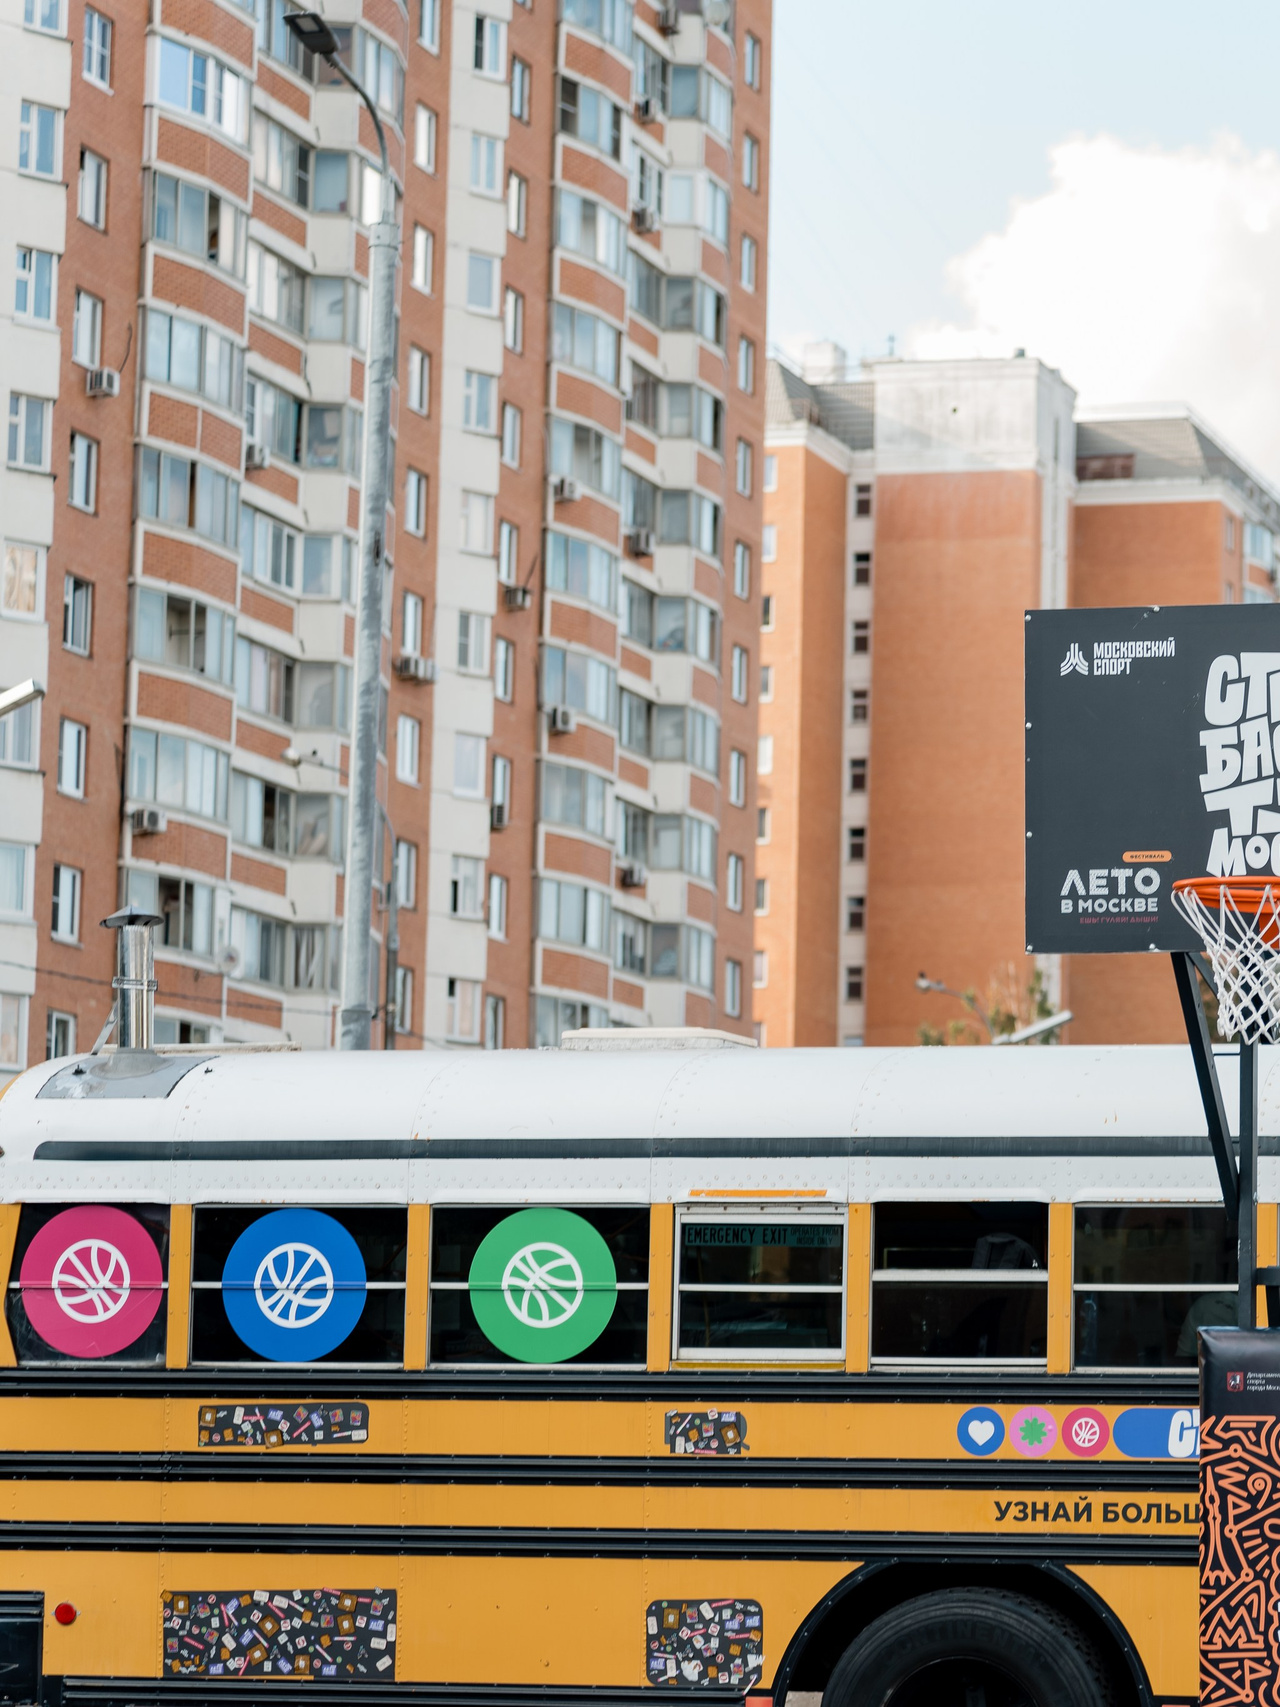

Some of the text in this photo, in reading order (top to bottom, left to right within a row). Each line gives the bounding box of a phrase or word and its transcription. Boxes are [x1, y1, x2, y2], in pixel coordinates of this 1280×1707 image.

[1093, 636, 1176, 659] МОСКОВСКИЙ
[1093, 658, 1133, 676] СПОРТ
[1060, 867, 1161, 897] ЛЕТО
[1060, 897, 1159, 914] В МОСКВЕ
[686, 1226, 788, 1245] EMERGENCY EXIT
[994, 1496, 1093, 1522] УЗНАЙ
